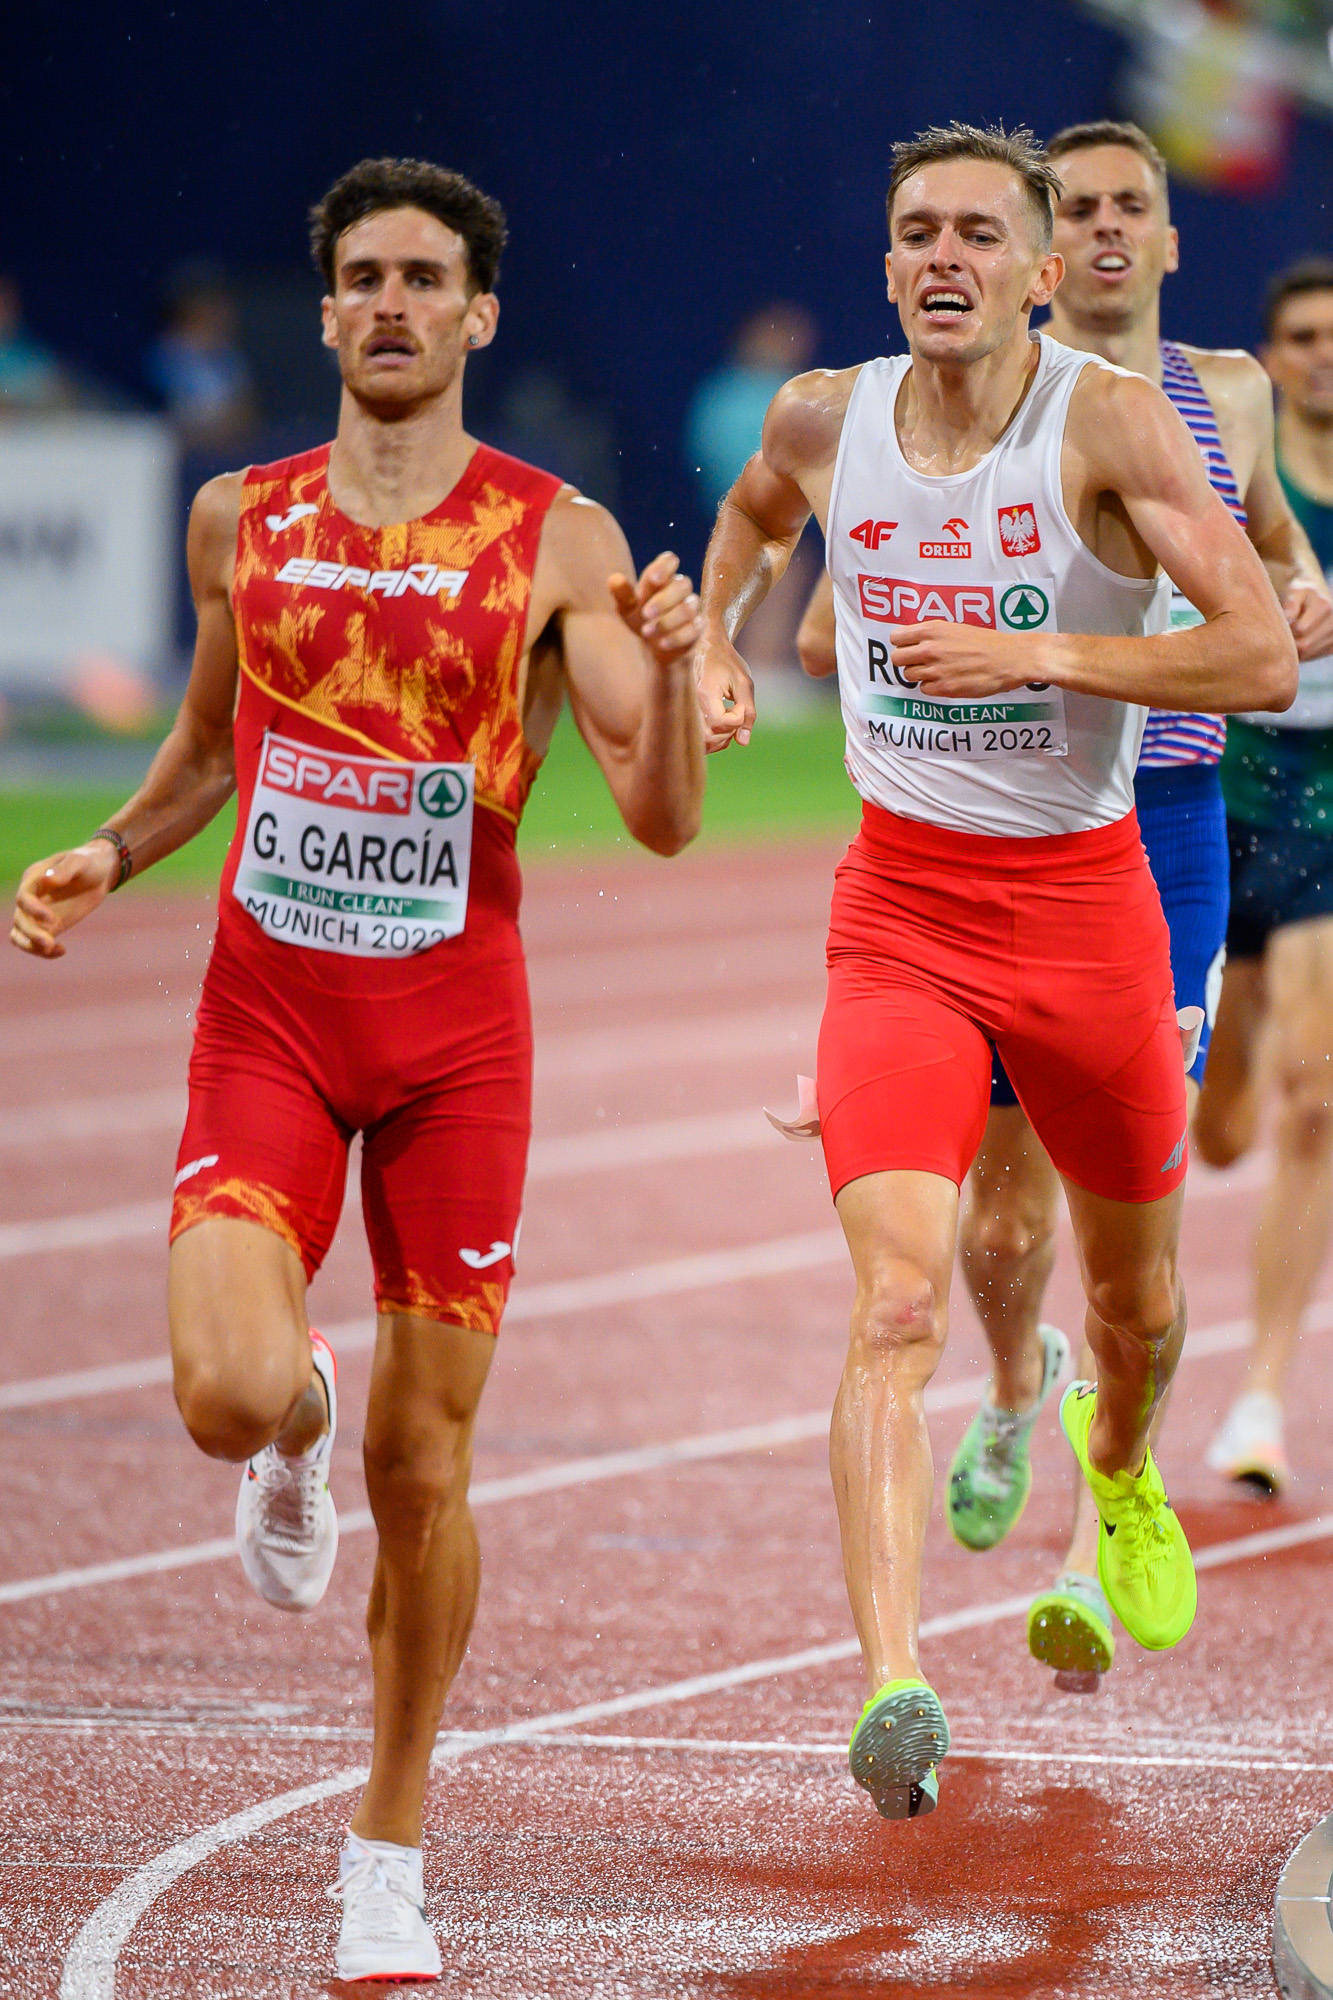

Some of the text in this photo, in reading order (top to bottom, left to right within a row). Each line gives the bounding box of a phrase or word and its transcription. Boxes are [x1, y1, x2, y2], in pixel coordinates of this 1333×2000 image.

[849, 519, 899, 550] 4F
[922, 544, 969, 557] ORLEN
[274, 557, 469, 598] ESPAÑA
[863, 582, 992, 624] SPAR
[903, 700, 908, 715] I
[911, 701, 944, 721] RUN
[868, 720, 1052, 752] MUNICH 2022
[265, 746, 409, 809] SPAR
[253, 811, 459, 888] G. GARCÍA
[287, 882, 293, 896] I
[297, 883, 335, 901] RUN
[245, 896, 360, 946] MUNICH
